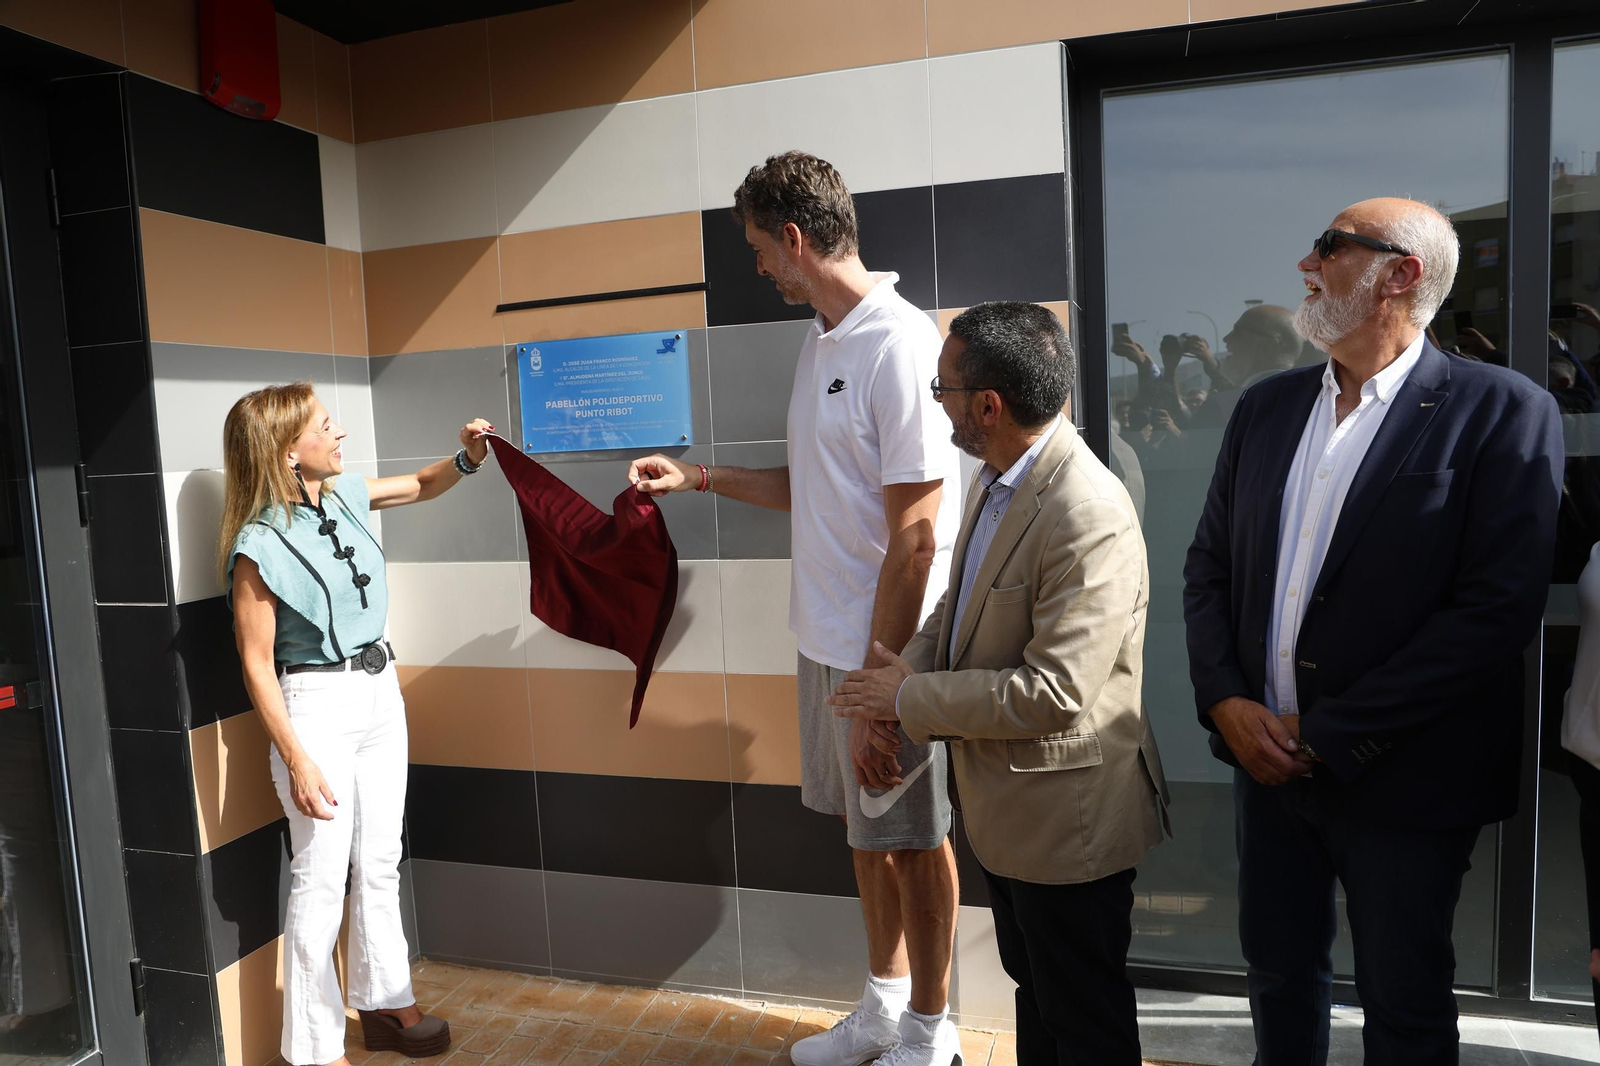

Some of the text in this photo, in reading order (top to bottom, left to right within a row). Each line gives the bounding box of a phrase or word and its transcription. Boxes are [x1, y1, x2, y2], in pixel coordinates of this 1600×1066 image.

[545, 394, 663, 409] PABELLÓN POLIDEPORTIVO
[576, 407, 633, 418] PUNTO RIBOT
